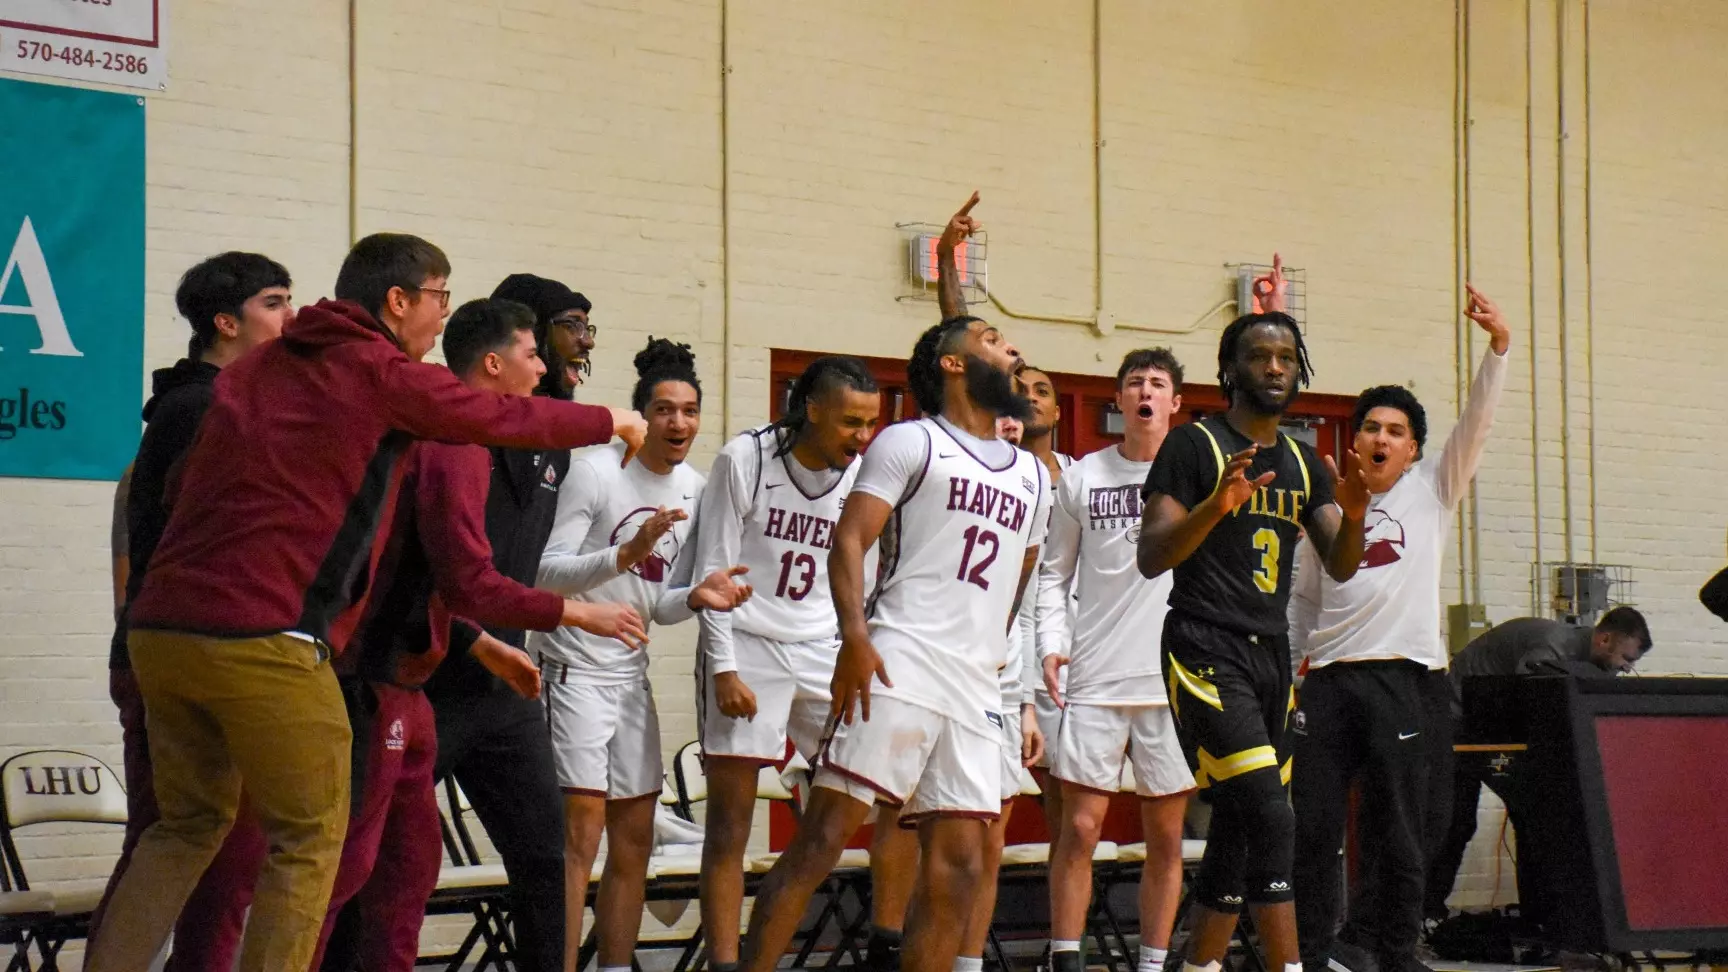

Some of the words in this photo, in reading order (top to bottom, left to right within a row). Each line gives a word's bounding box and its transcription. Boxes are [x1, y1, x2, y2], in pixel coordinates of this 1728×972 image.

[17, 39, 149, 75] 570-484-2586
[946, 476, 1028, 535] HAVEN
[1090, 489, 1129, 517] LOCK
[776, 550, 816, 602] 13
[957, 525, 999, 591] 12
[1252, 527, 1280, 594] 3
[18, 766, 102, 795] LHU
